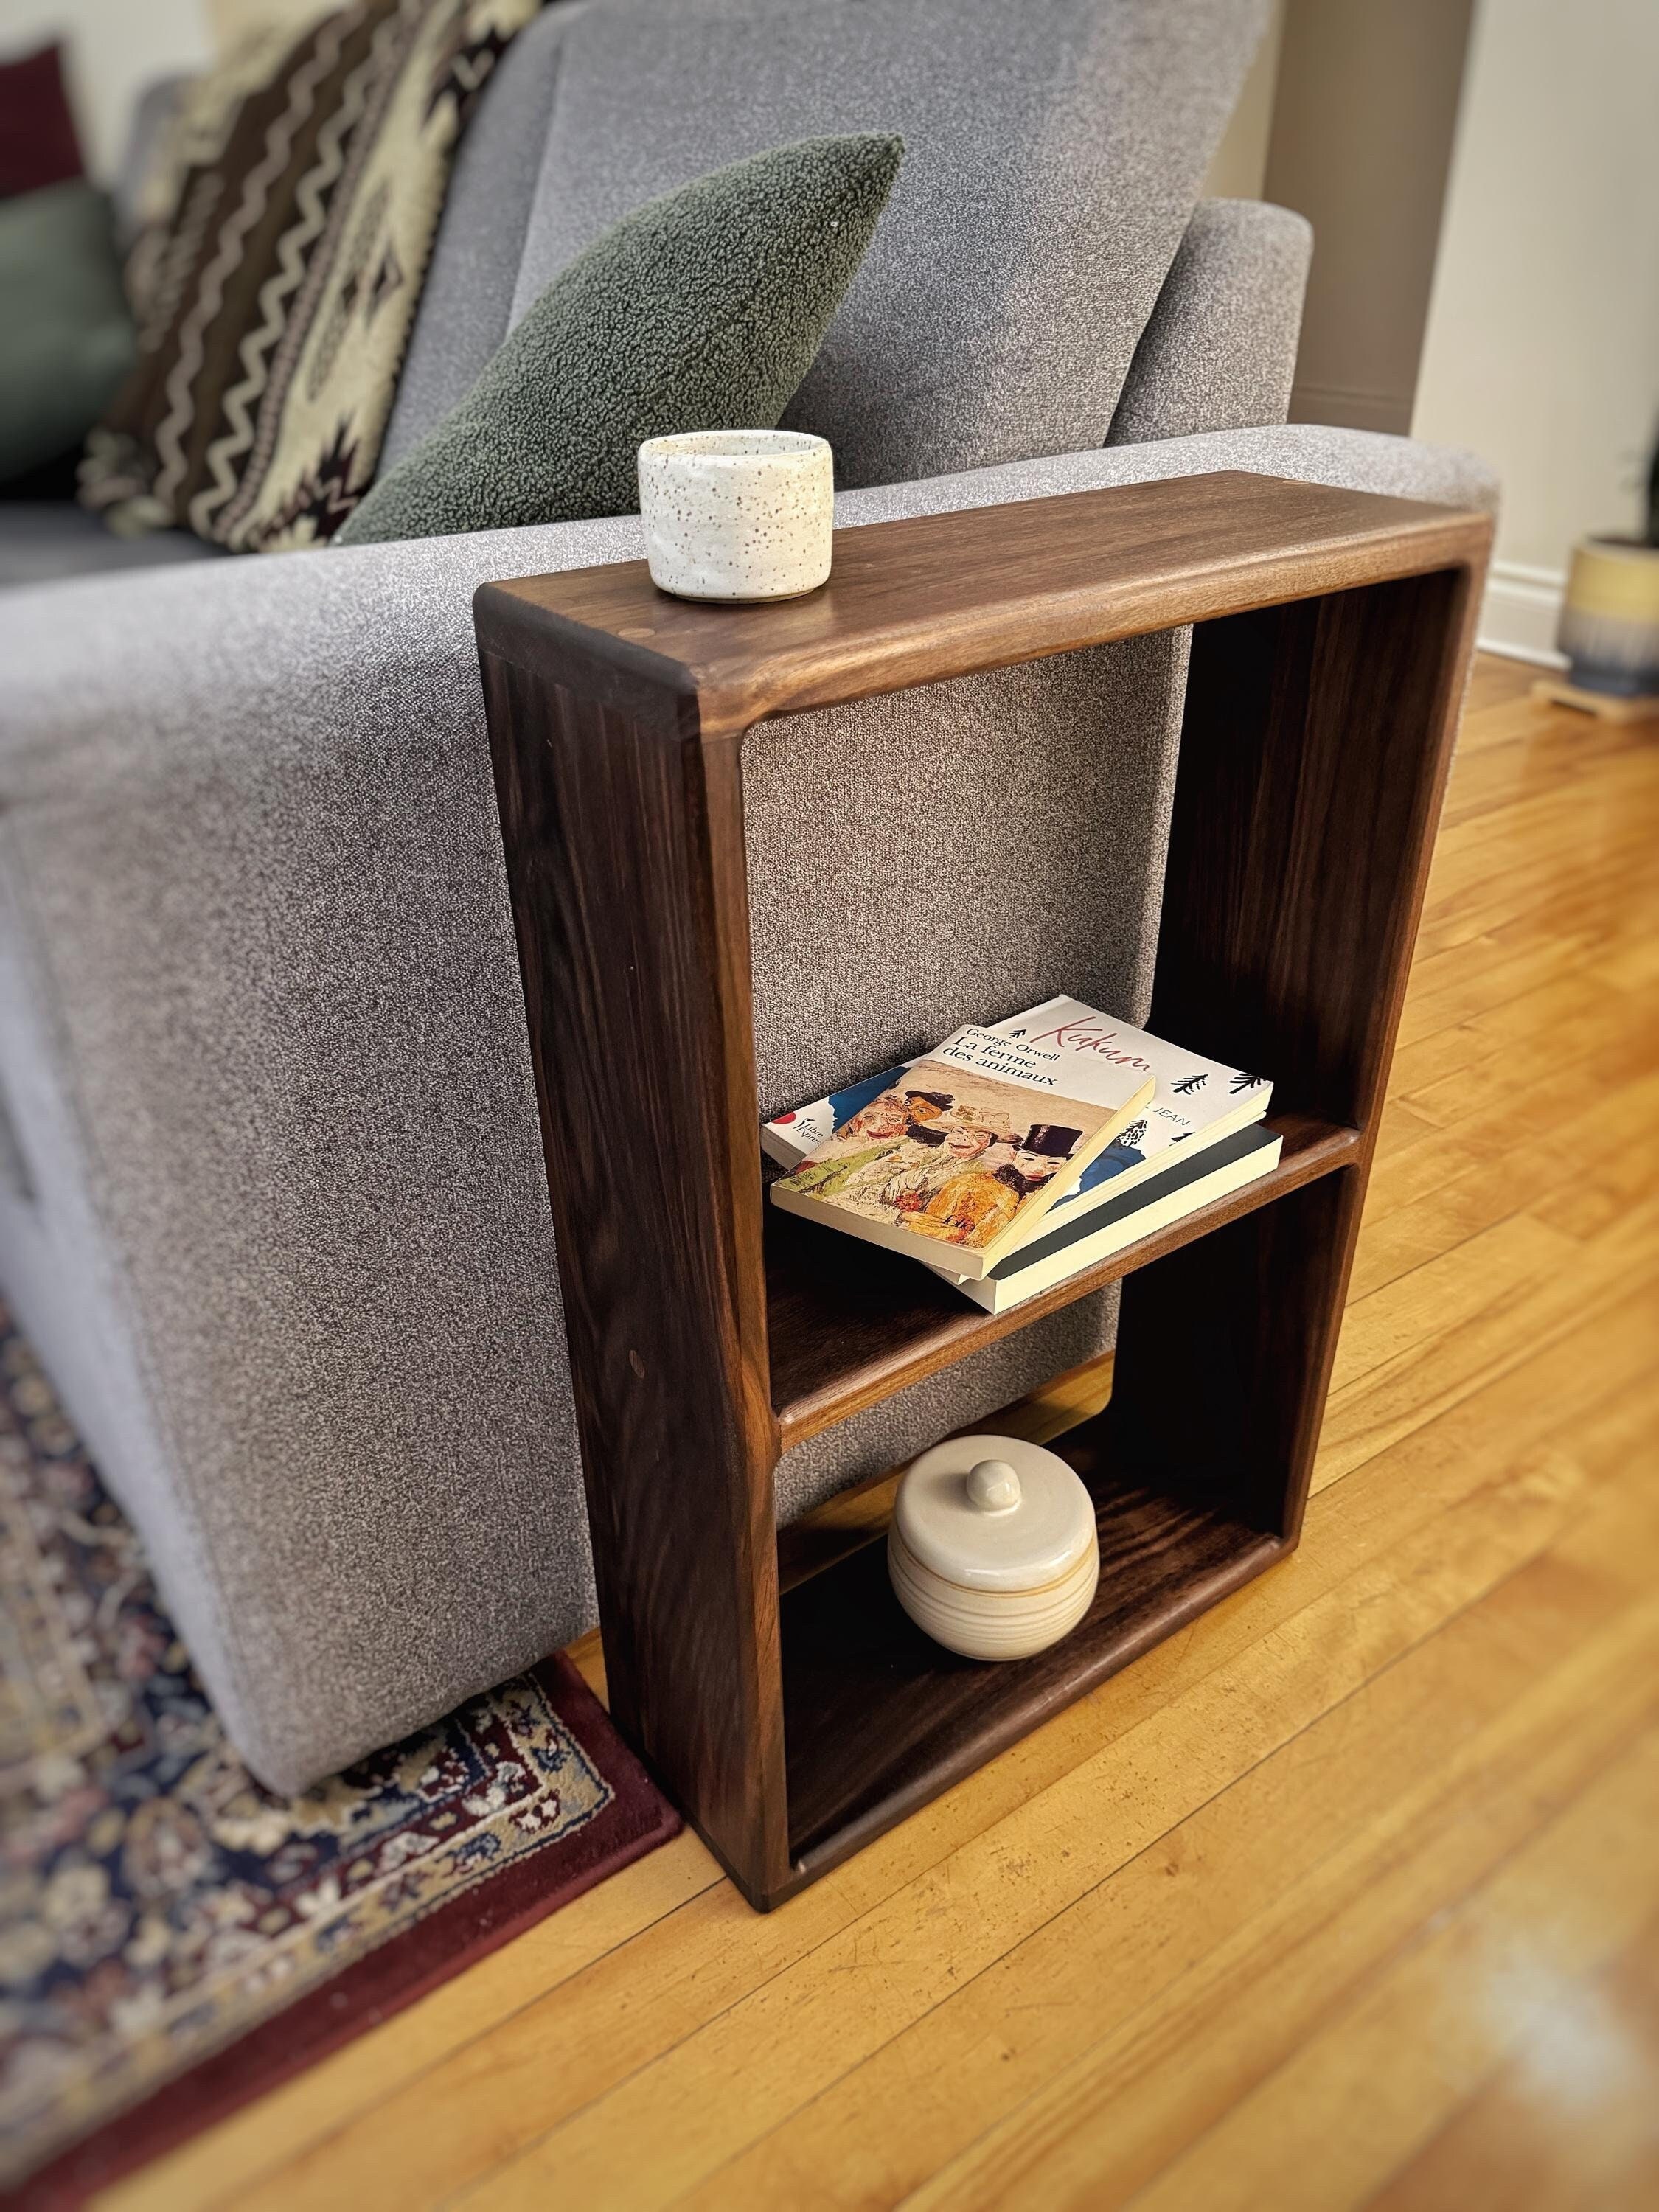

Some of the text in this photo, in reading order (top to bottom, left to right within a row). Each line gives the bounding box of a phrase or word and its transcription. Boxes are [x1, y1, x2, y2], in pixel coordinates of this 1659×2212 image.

[953, 1036, 1036, 1068] La ferme
[967, 1028, 1060, 1061] George Orwell
[1029, 1016, 1150, 1071] Kukum
[942, 1047, 1058, 1086] des animaux
[804, 1124, 824, 1137] Libre
[1152, 1107, 1191, 1126] JEAN
